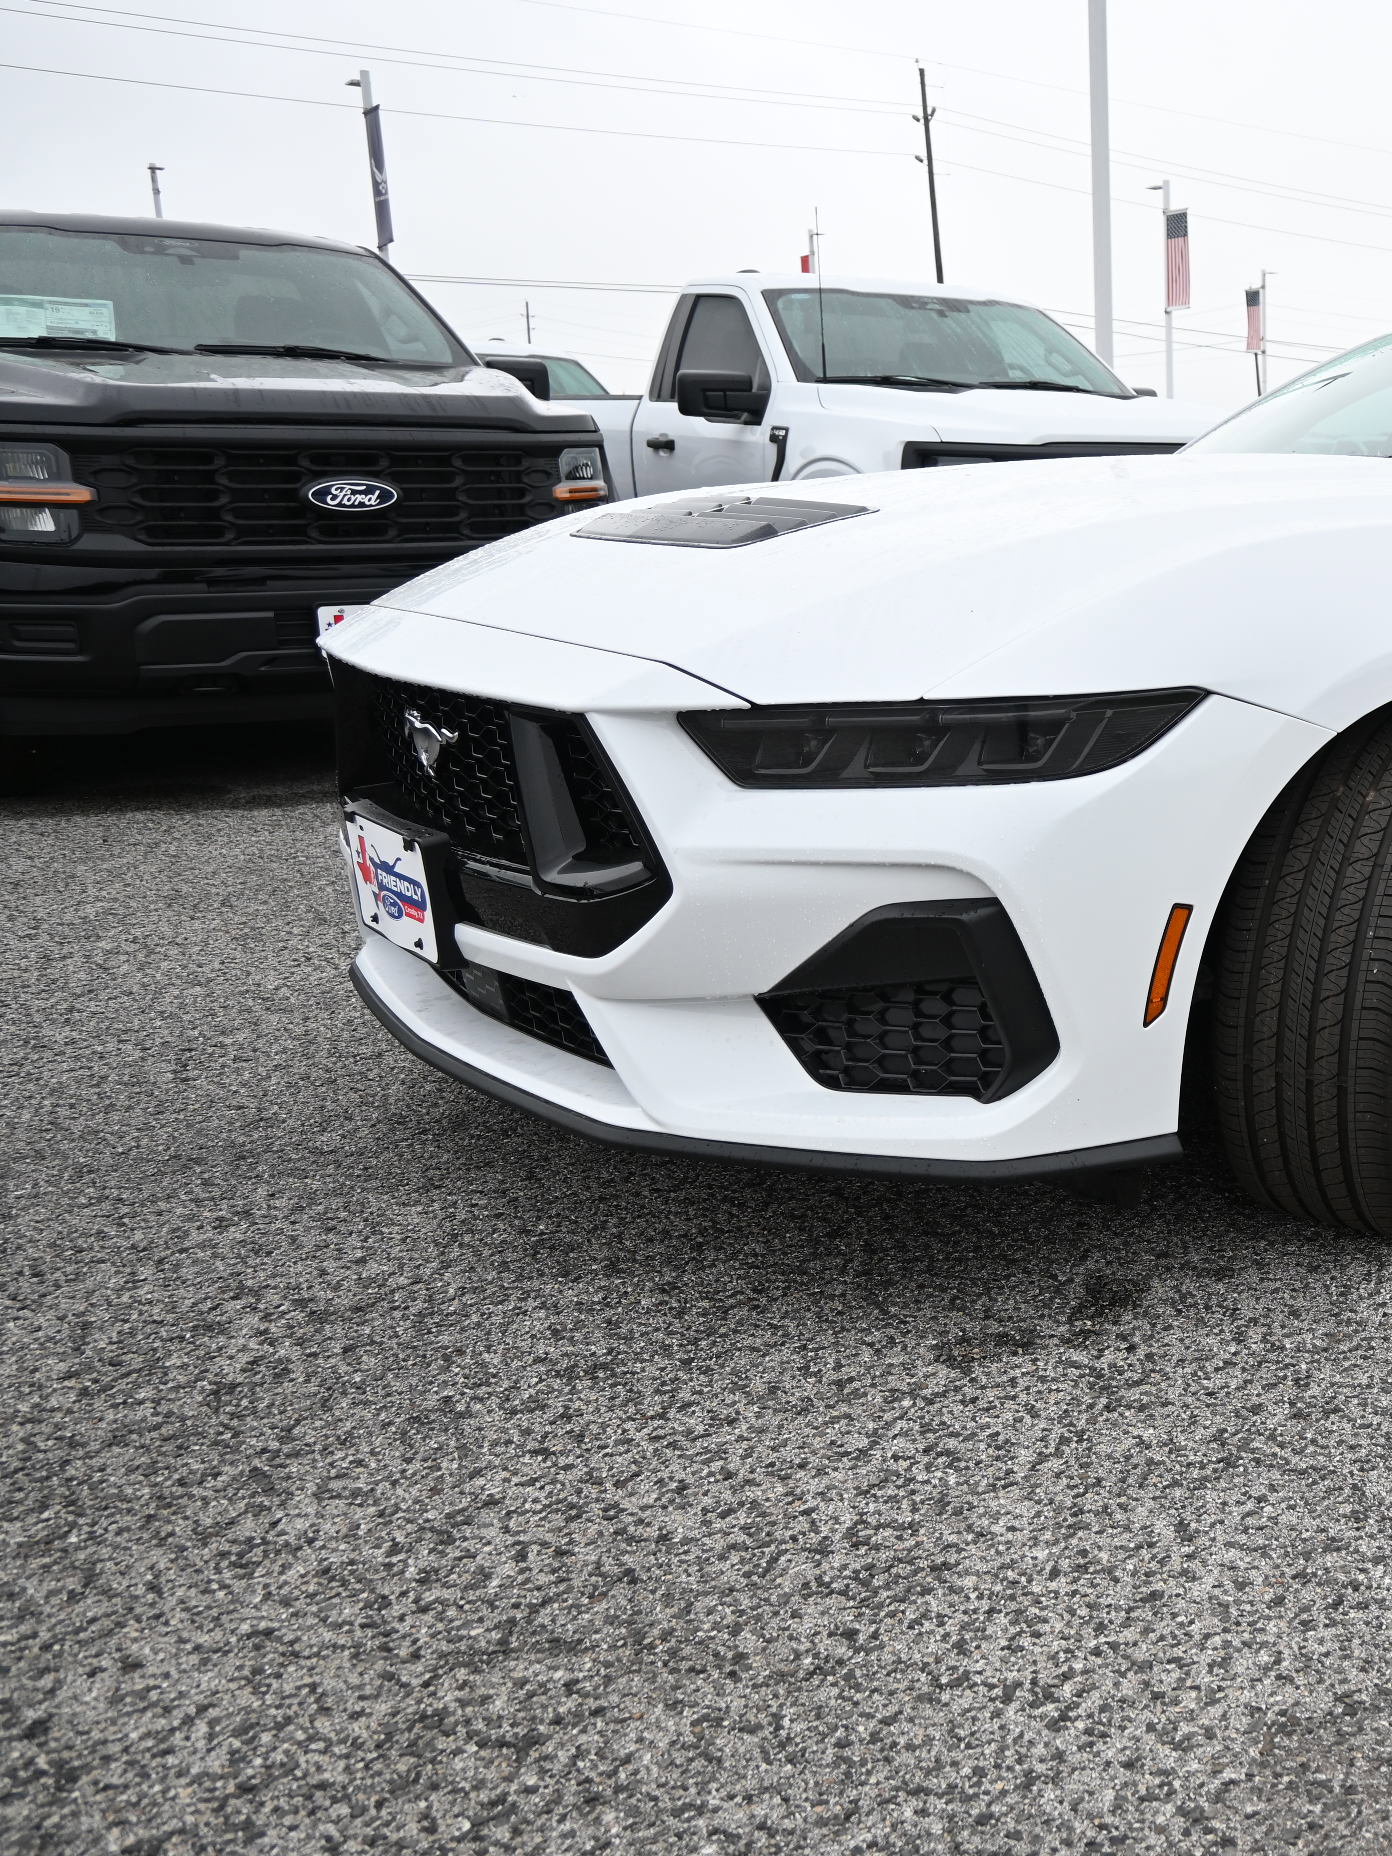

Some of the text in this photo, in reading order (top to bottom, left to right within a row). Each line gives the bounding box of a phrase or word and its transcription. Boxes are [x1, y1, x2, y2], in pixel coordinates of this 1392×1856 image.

[327, 484, 380, 505] Ford
[378, 869, 421, 902] FRIENDLY
[384, 895, 399, 917] Ford
